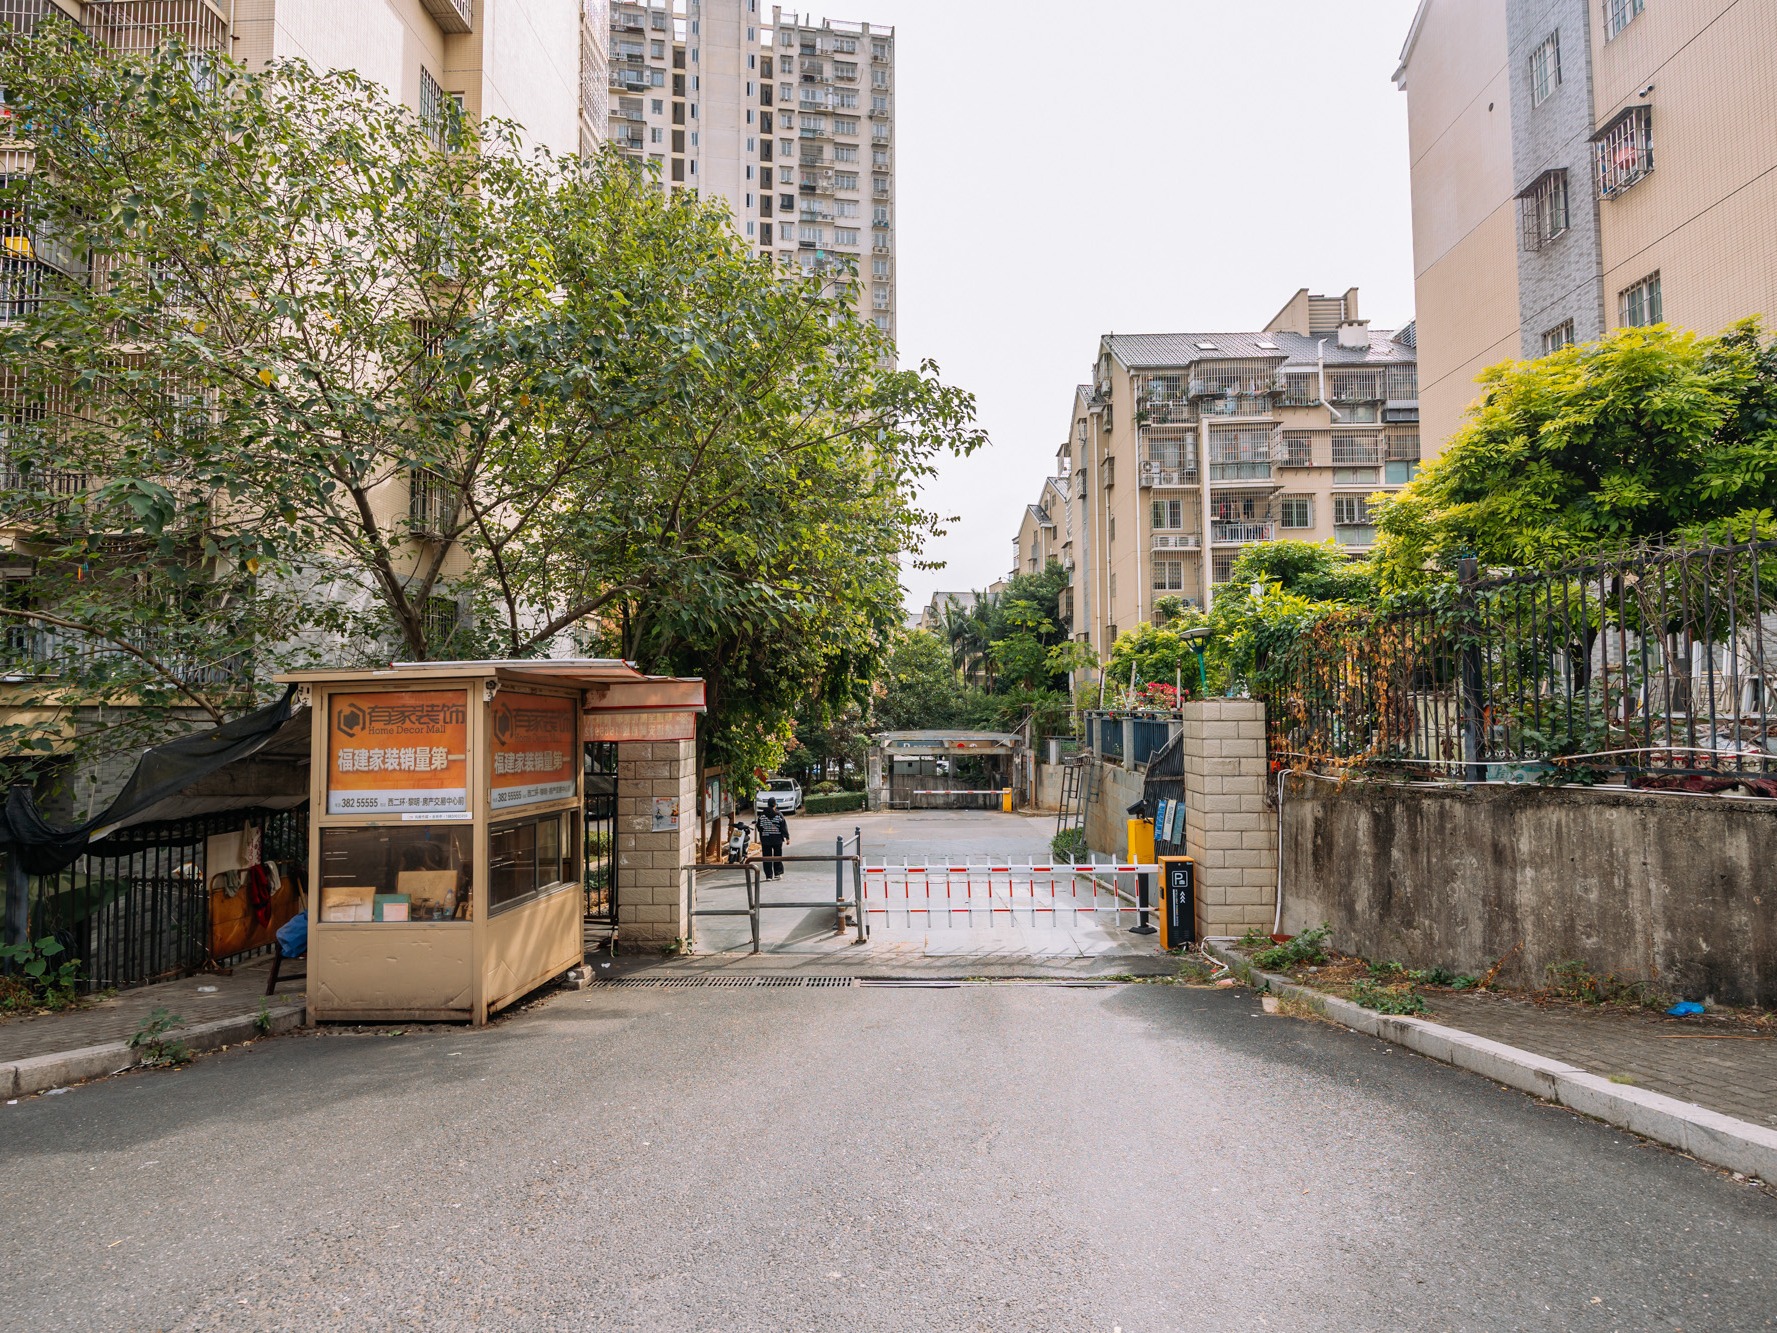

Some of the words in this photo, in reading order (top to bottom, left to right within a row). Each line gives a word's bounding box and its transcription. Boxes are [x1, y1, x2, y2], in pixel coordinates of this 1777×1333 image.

[367, 703, 466, 726] 有家装饰
[368, 726, 394, 735] Home
[396, 725, 424, 735] Decor
[426, 724, 446, 734] Mall
[337, 746, 466, 772] 福建家装销量第一
[494, 750, 571, 775] 福建家装销量第一
[341, 798, 355, 808] 382
[356, 797, 379, 808] 55555
[497, 793, 507, 803] 382
[508, 791, 522, 801] 55555
